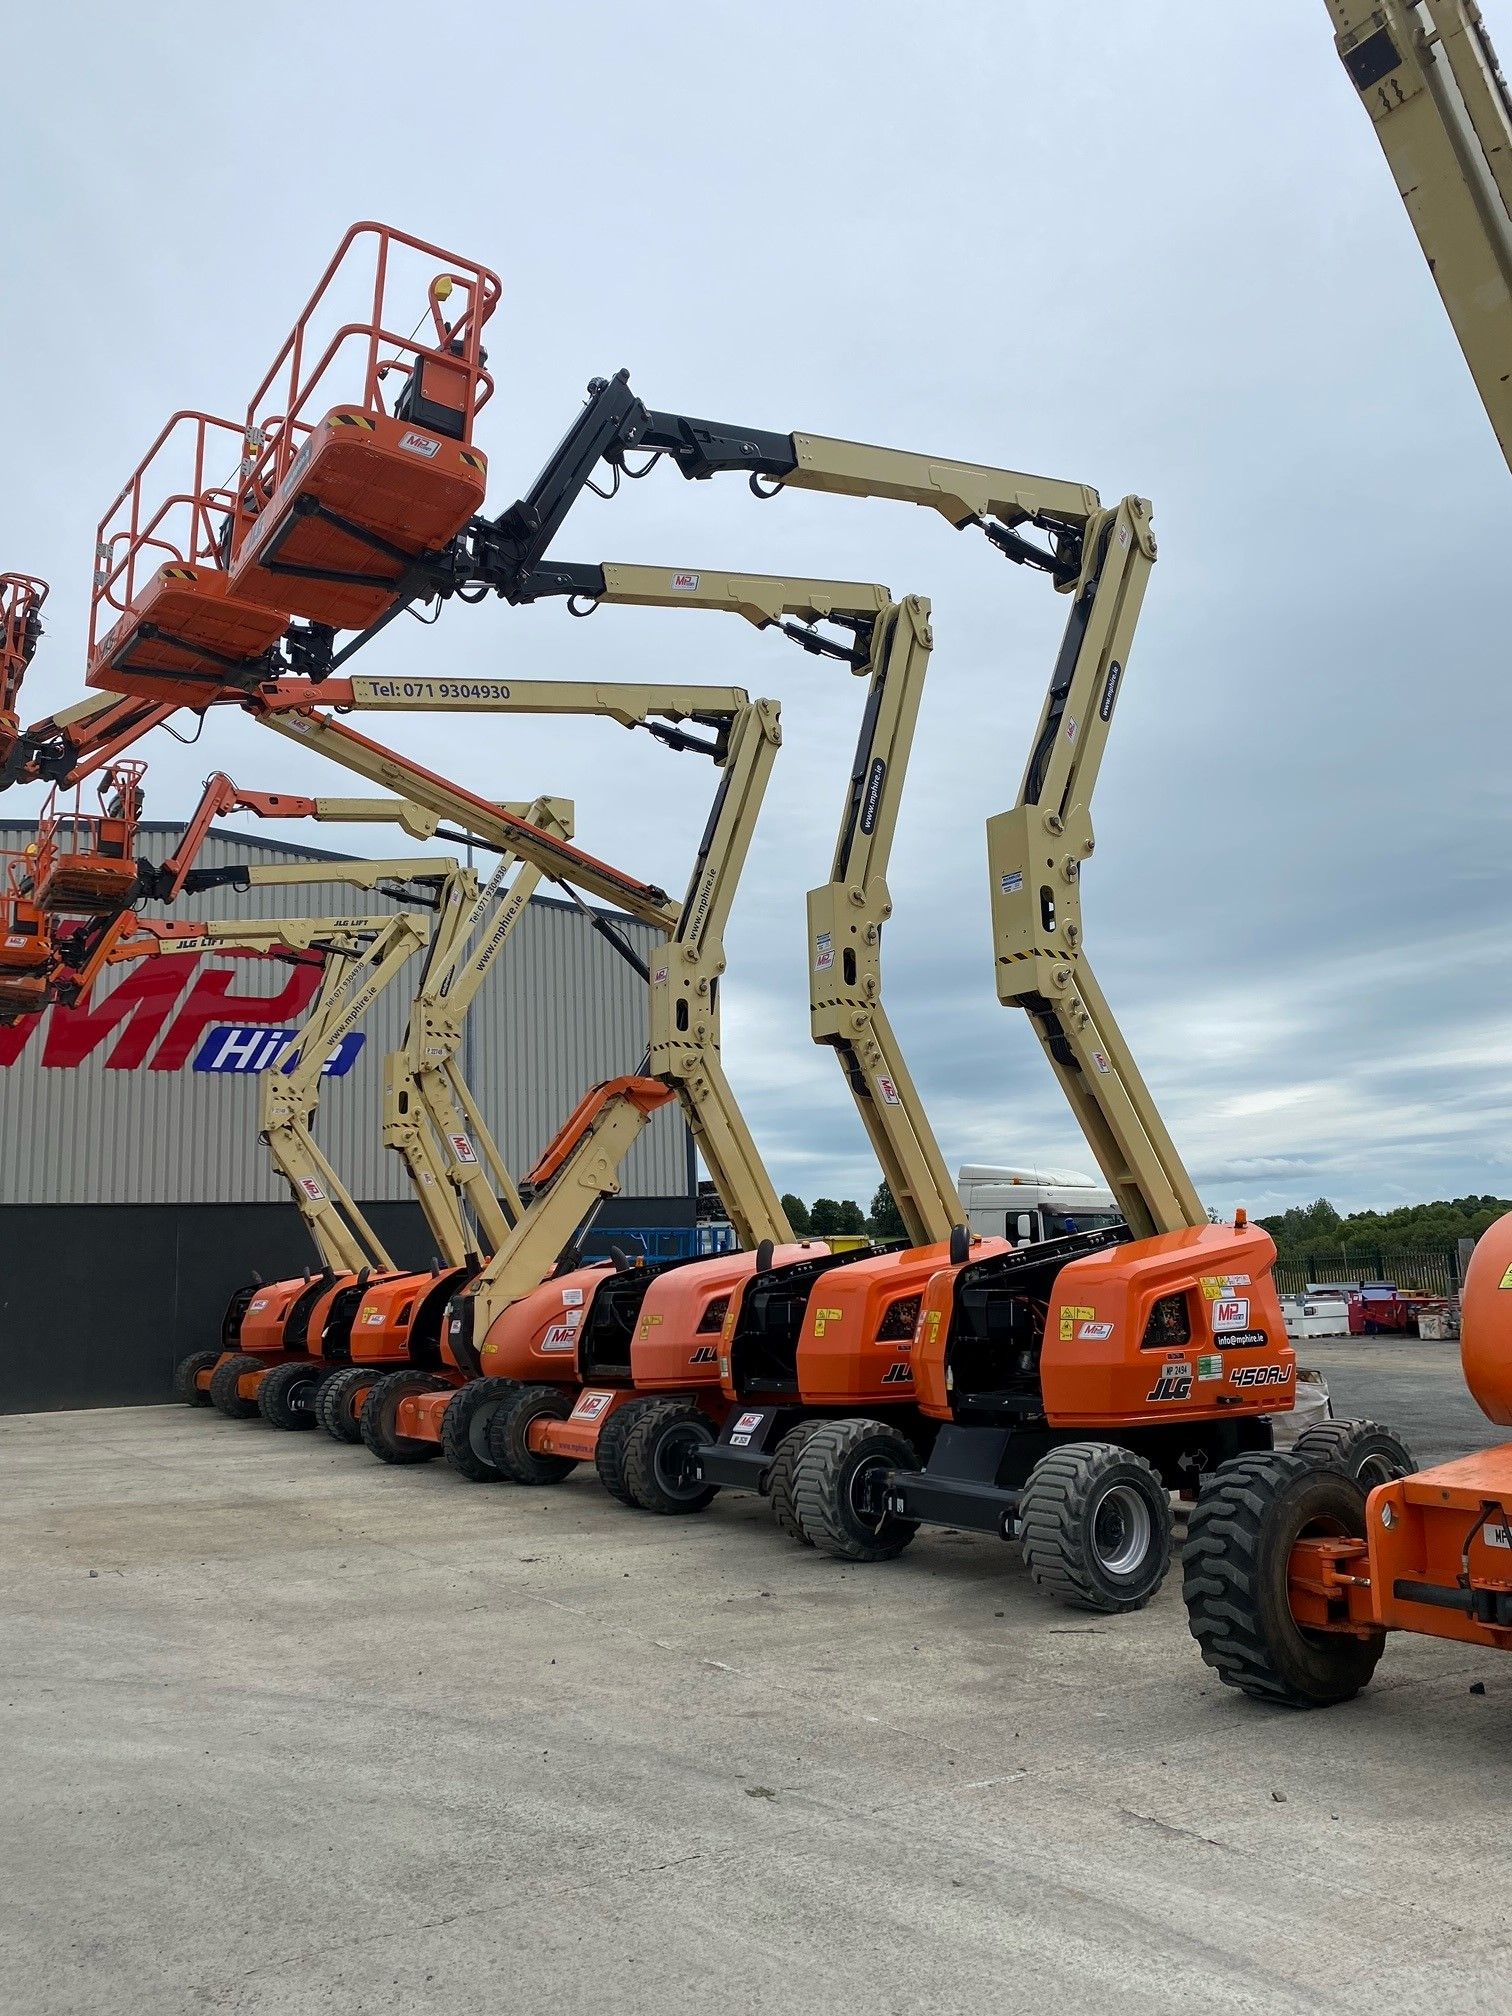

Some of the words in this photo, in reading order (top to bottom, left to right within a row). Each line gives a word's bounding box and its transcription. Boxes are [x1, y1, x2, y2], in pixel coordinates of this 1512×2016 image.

[675, 575, 692, 586] MP
[369, 681, 400, 697] Tel:
[403, 683, 434, 698] 071
[439, 684, 511, 699] 9304930
[865, 764, 882, 828] www.mphire.ie
[469, 910, 483, 925] Tel:
[477, 897, 491, 912] 071
[485, 865, 507, 898] 9304930
[690, 868, 717, 940] www.mphire.ie
[176, 939, 198, 949] JLG
[200, 937, 225, 948] LIFT
[476, 895, 524, 971] www.mphire.ie
[326, 986, 378, 1047] www.mphire.ie
[1218, 1303, 1240, 1321] MP
[551, 1329, 576, 1342] MP
[1217, 1333, 1264, 1346] info@mphire.ie
[1229, 1363, 1293, 1388] 450AJ
[1146, 1376, 1193, 1401] JLG
